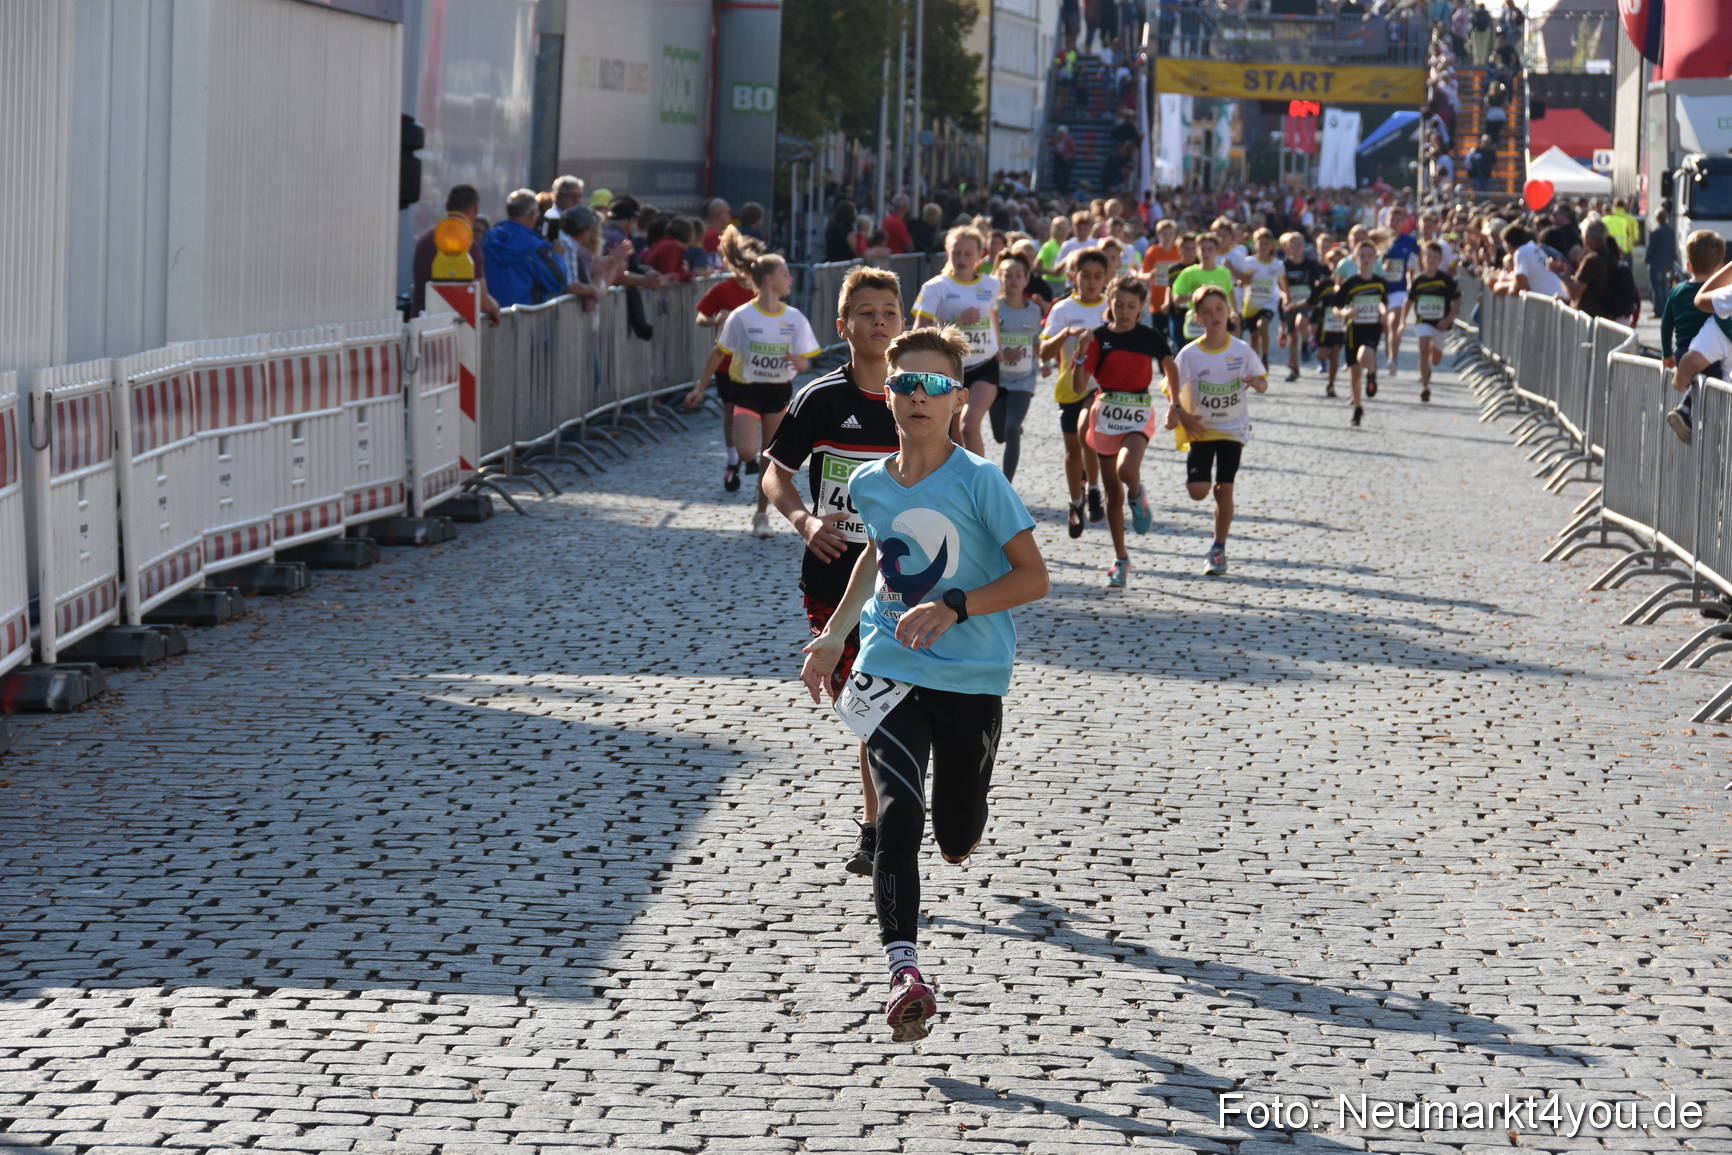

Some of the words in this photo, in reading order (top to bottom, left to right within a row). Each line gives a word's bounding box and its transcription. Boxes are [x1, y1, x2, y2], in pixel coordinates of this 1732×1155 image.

[1244, 69, 1335, 93] START
[1201, 393, 1238, 409] 4038
[1102, 405, 1144, 422] 4046
[833, 521, 866, 533] ENE
